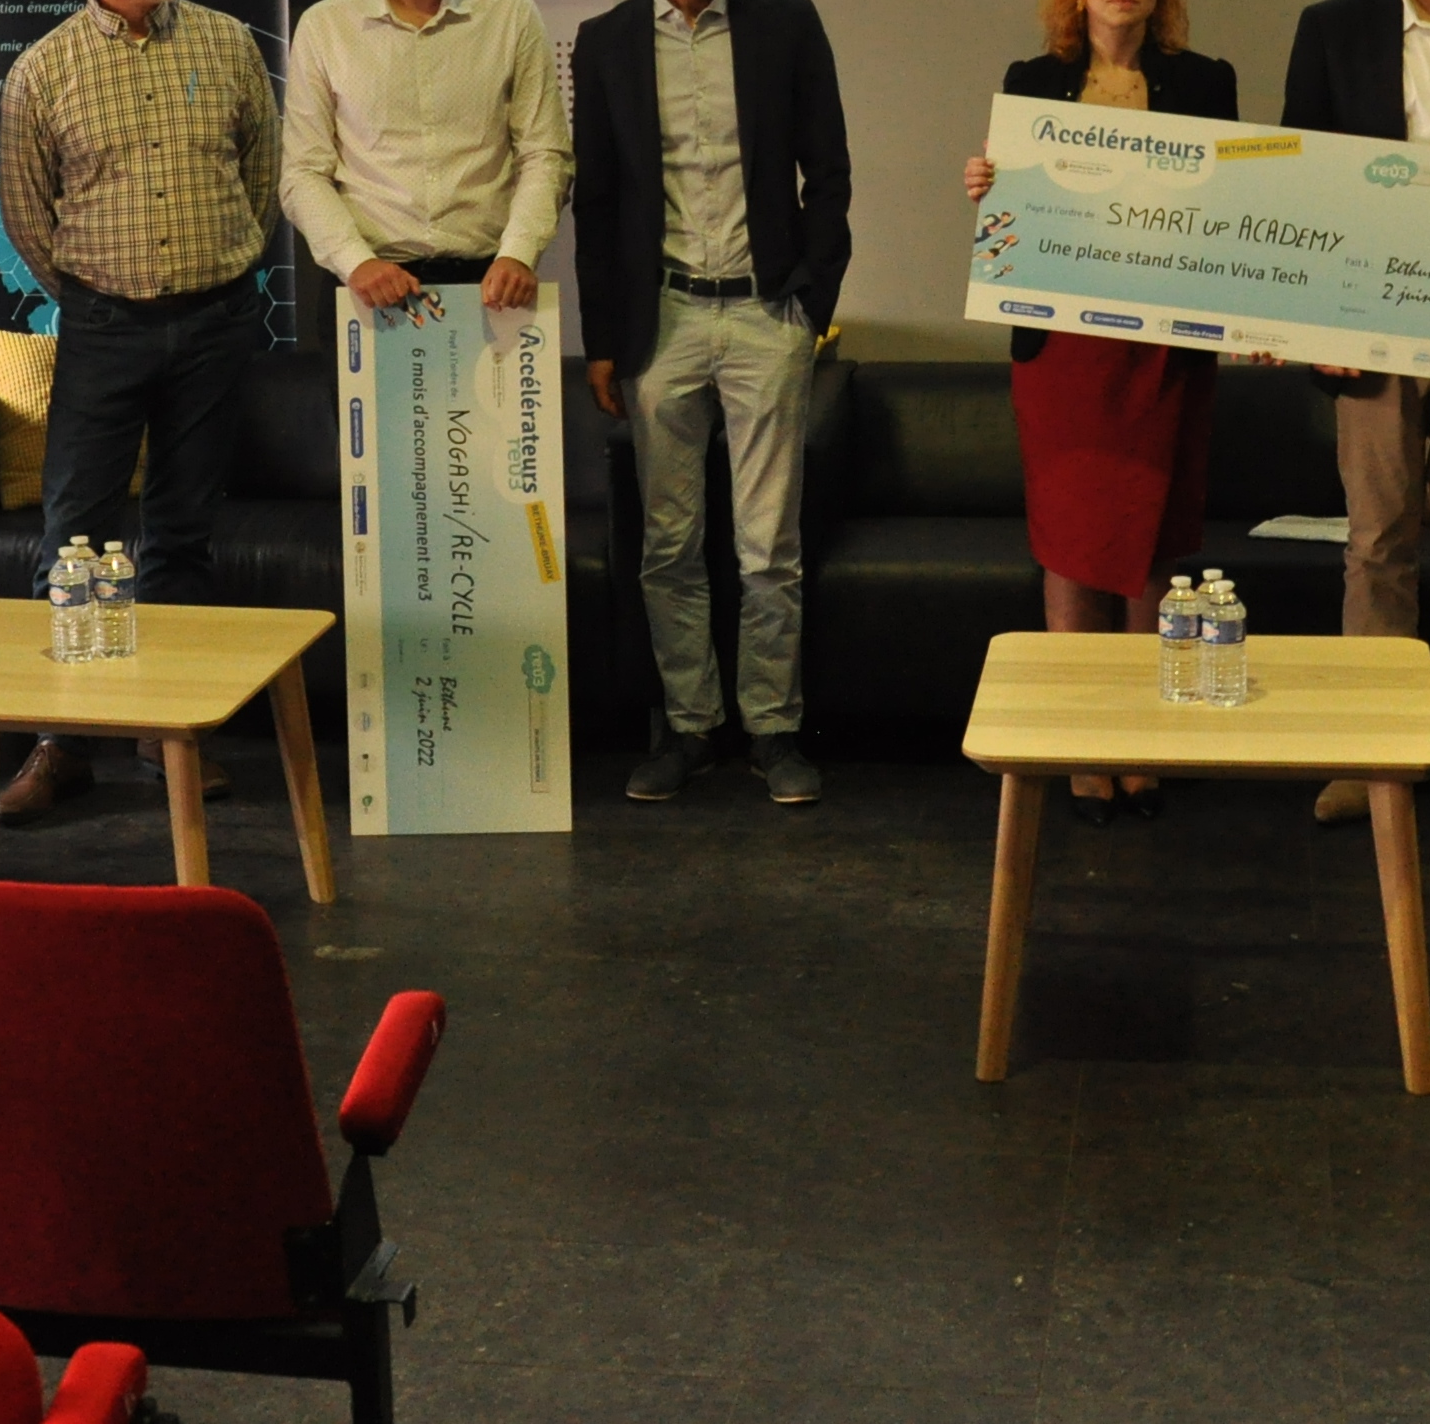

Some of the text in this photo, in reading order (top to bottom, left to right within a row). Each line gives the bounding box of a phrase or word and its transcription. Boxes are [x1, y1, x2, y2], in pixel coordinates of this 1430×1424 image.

[1036, 119, 1207, 161] Accélérateurs
[1106, 201, 1202, 236] SMART
[1237, 214, 1346, 253] ACADEMY
[1037, 238, 1309, 287] Une place stand Salon Viva Tech
[1381, 282, 1395, 301] 2
[518, 330, 543, 494] Accélérateurs
[411, 347, 433, 602] 6 mois d'accompagnement rev3
[411, 677, 435, 768] 2 juin 2022
